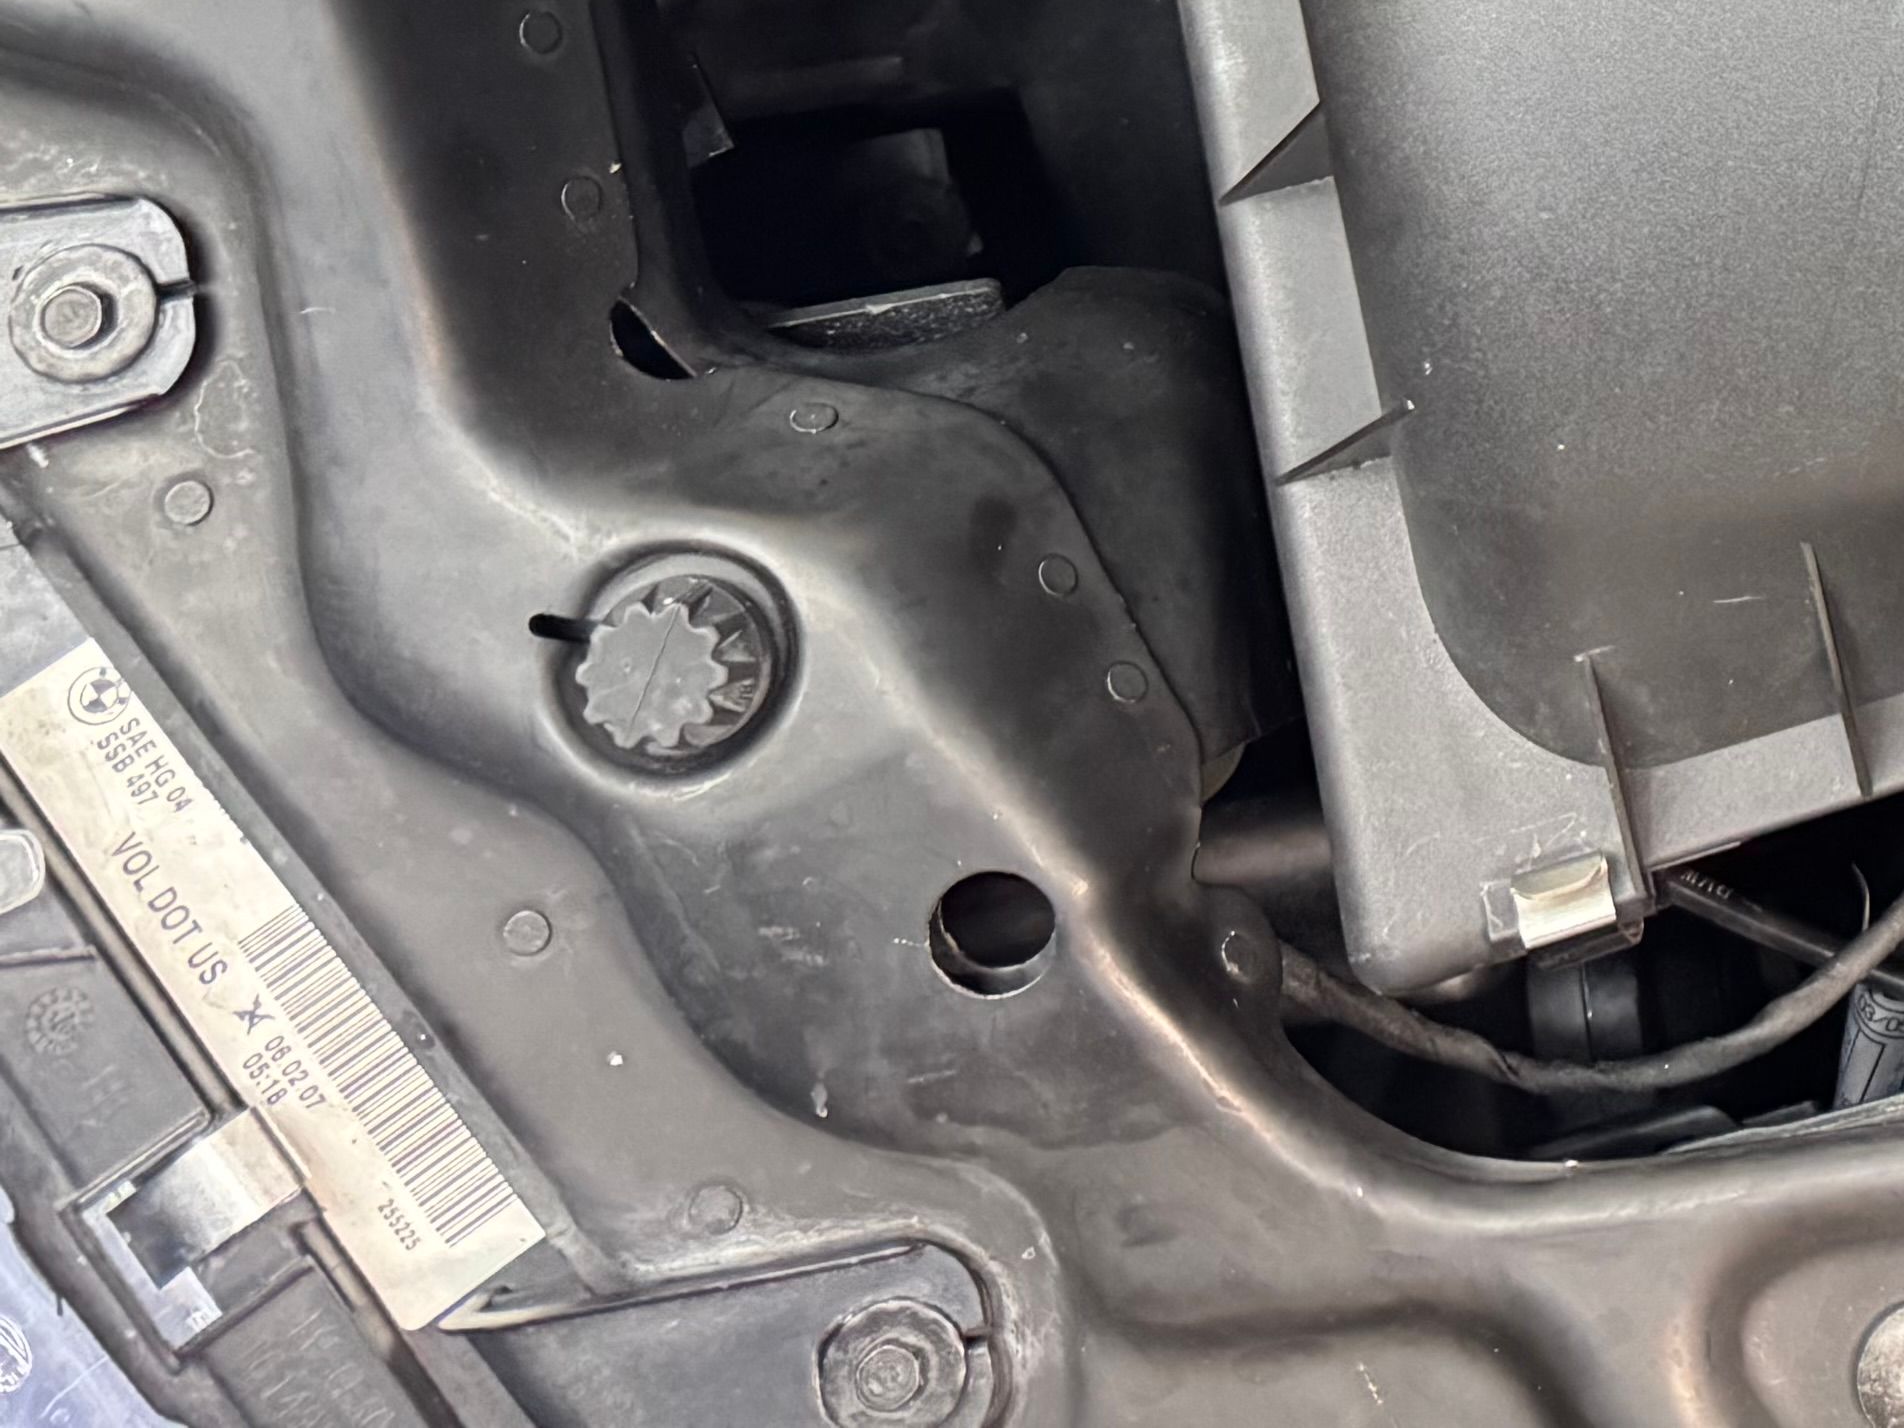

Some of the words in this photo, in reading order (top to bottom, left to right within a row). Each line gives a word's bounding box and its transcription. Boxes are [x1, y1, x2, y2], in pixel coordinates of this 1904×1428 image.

[97, 733, 134, 772] SSB
[127, 774, 158, 804] 497
[120, 718, 156, 757] SAE
[145, 756, 175, 787] HG
[167, 787, 192, 812] 04
[112, 832, 159, 893] VOL
[148, 887, 202, 944] DOT
[188, 943, 227, 984] US
[243, 1053, 287, 1105] 05:18
[378, 1199, 420, 1250] 255225
